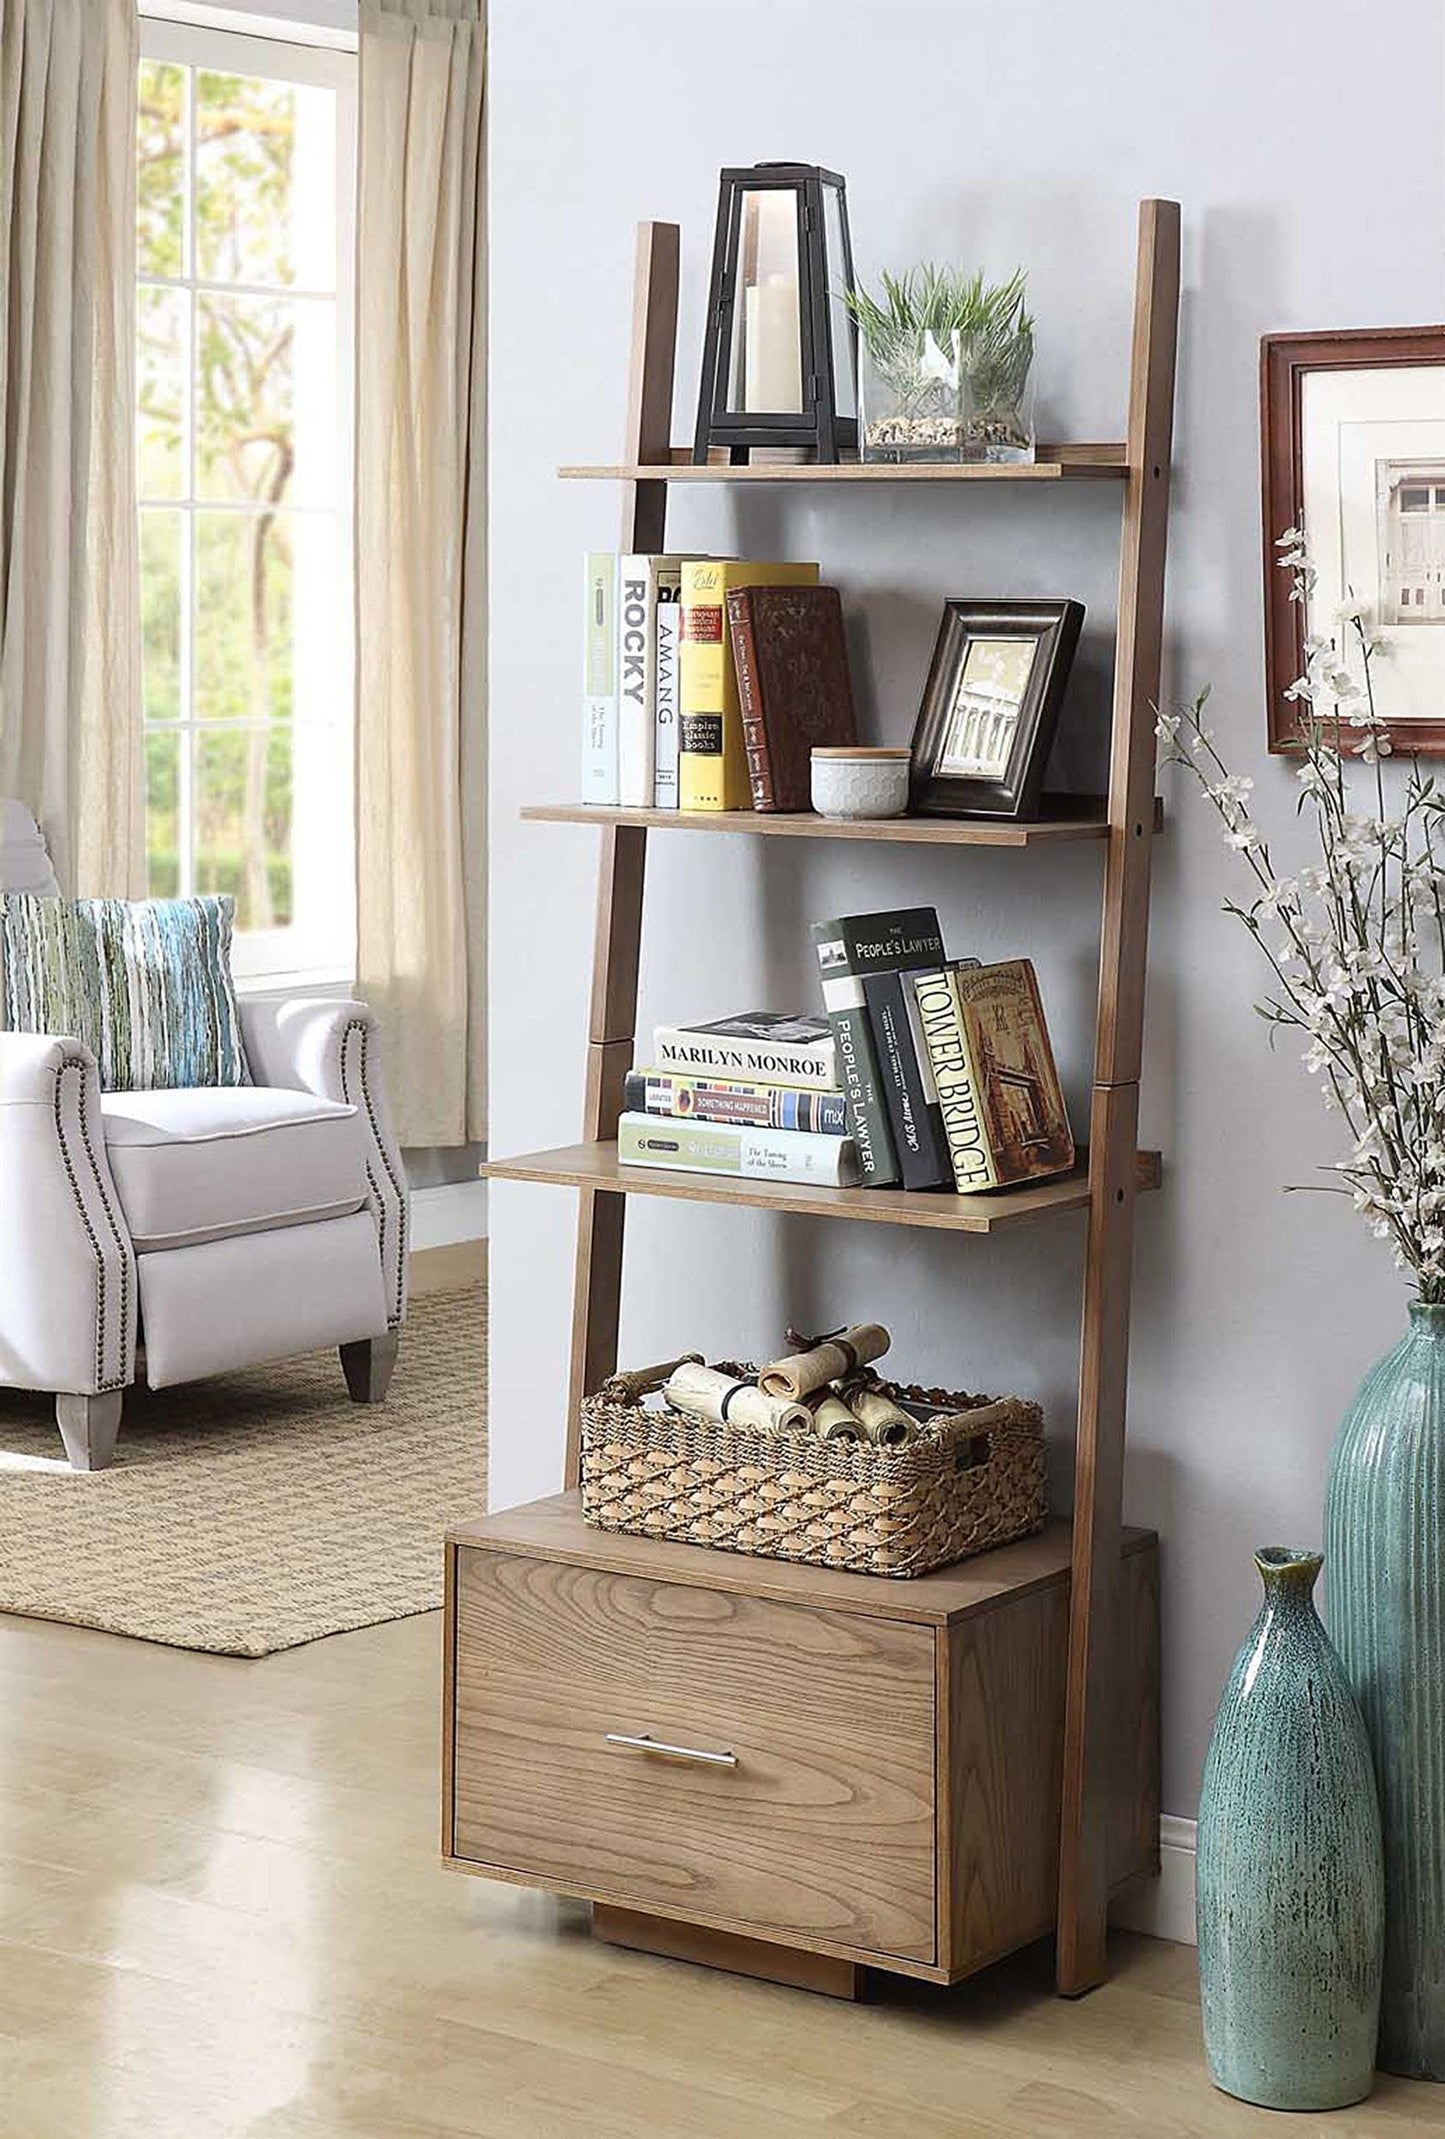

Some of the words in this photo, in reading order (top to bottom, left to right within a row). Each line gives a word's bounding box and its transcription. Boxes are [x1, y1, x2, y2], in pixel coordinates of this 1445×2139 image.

[623, 579, 646, 705] ROCKY
[659, 624, 673, 724] AMANG
[684, 740, 716, 750] books
[855, 940, 902, 959] PEOPLE'S
[902, 937, 941, 953] LAWYER
[661, 1044, 743, 1067] MARILYN
[747, 1053, 827, 1077] MONROE
[917, 973, 967, 1079] TOWER
[837, 1019, 861, 1099] PEOPLE'S
[852, 1102, 875, 1173] LAWYER
[864, 1082, 874, 1103] THE
[938, 1079, 990, 1188] BRIDGE
